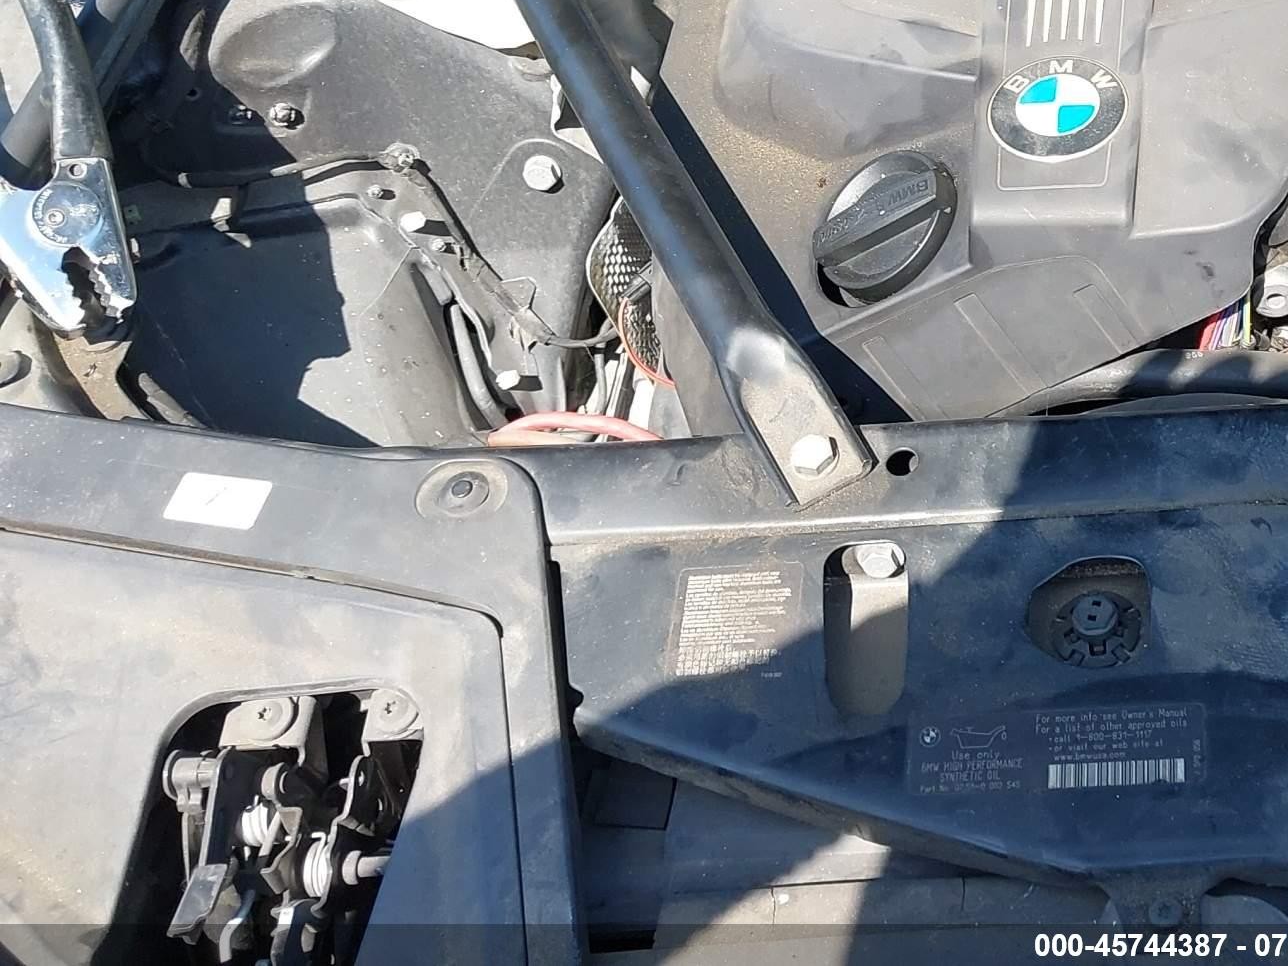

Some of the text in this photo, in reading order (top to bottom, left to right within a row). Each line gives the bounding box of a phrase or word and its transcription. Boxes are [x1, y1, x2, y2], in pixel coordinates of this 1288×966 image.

[1003, 59, 1119, 94] BMW
[887, 179, 929, 207] BMW
[1035, 714, 1050, 724] For
[1055, 715, 1076, 723] more
[1158, 706, 1188, 718] Manual
[1035, 723, 1050, 734] For
[1127, 717, 1166, 731] approved
[951, 748, 1001, 761] Use only
[921, 761, 940, 773] BMW
[966, 757, 1024, 771] PERFORMANCE
[940, 770, 1001, 783] SYNTHETIC OIL
